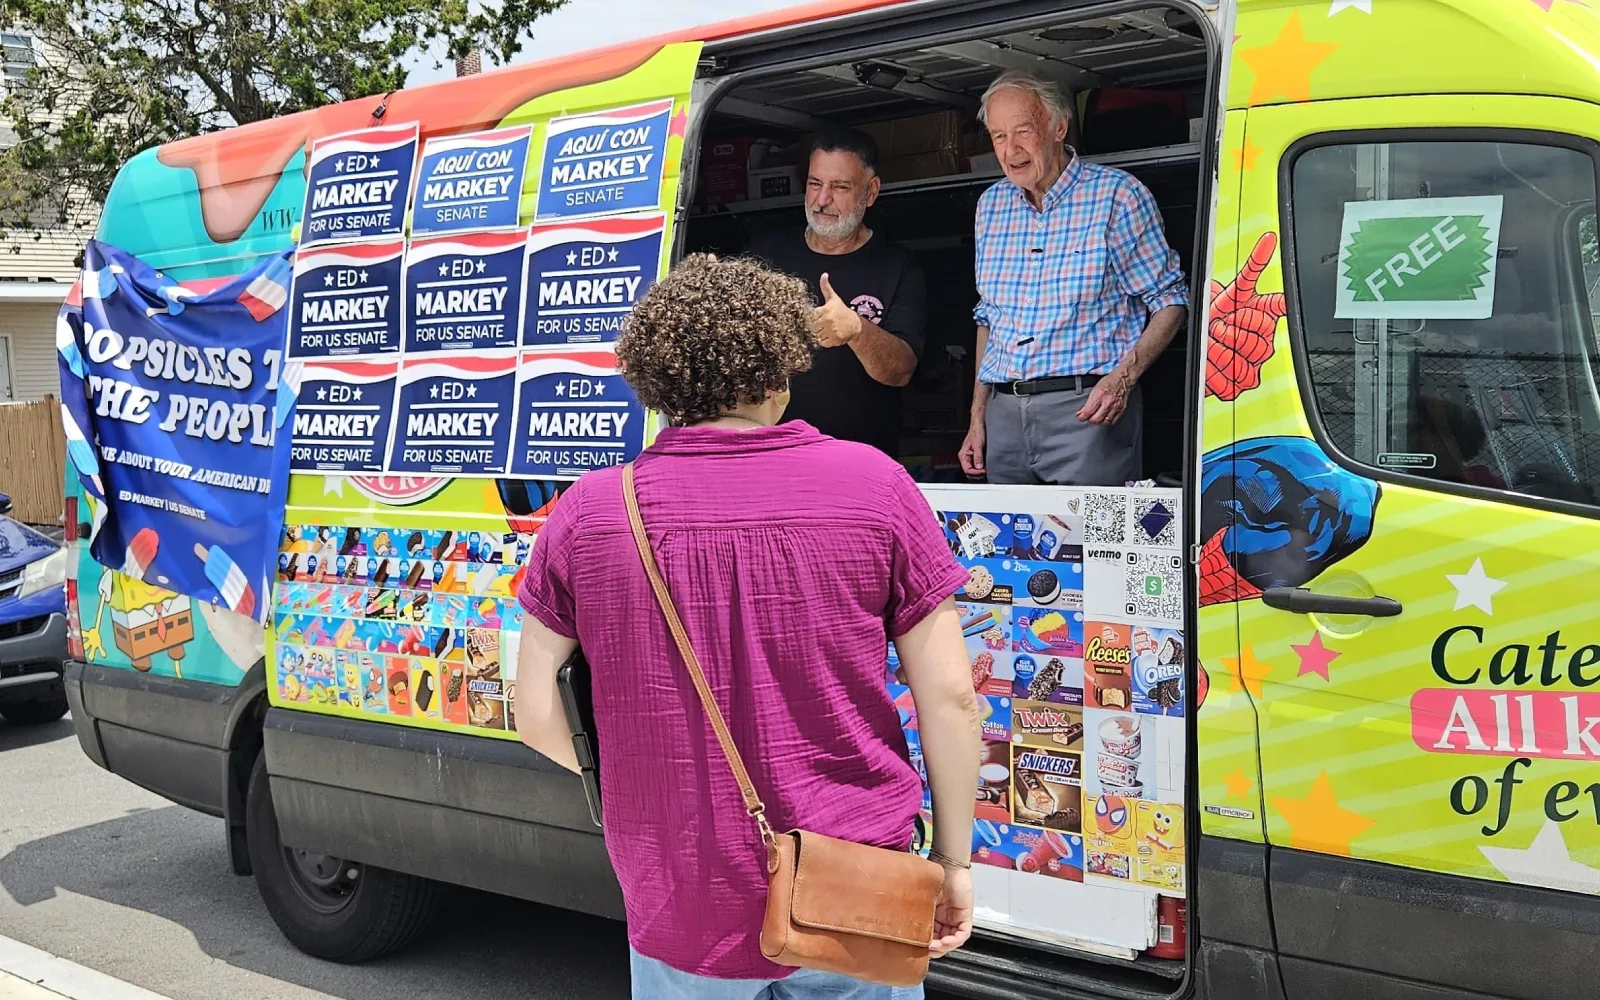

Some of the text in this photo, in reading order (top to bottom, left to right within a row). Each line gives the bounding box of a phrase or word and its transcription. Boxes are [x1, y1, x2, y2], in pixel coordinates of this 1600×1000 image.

[559, 126, 651, 156] AQUÍ CON
[346, 155, 367, 172] ED
[433, 149, 512, 175] AQUÍ CON
[551, 154, 653, 185] MARKEY
[312, 179, 398, 210] MARKEY
[424, 175, 514, 201] MARKEY
[565, 187, 624, 206] SENATE
[309, 213, 391, 233] FOR US SENATE
[436, 205, 488, 222] SENATE
[581, 247, 604, 266] ED
[1364, 216, 1466, 301] FREE
[452, 259, 474, 277] ED
[337, 270, 357, 287] ED
[416, 287, 508, 315] MARKEY
[539, 276, 642, 307] MARKEY
[302, 295, 389, 323] MARKEY
[416, 324, 504, 342] FOR US SENATE
[537, 320, 560, 334] FOR
[563, 318, 581, 332] US
[301, 331, 387, 347] FOR US SENATE
[329, 385, 351, 402] ED
[441, 382, 463, 400] ED
[569, 379, 591, 398] ED
[292, 414, 380, 436] MARKEY
[407, 413, 499, 436] MARKEY
[529, 412, 629, 437] MARKEY
[291, 447, 372, 462] FOR US SENATE
[403, 449, 493, 463] FOR US SENATE
[526, 450, 625, 466] FOR US SENATE
[117, 450, 153, 470] ABOUT
[154, 458, 192, 479] YOUR
[190, 468, 257, 491] AMERICAN
[119, 490, 131, 501] ED
[132, 493, 164, 508] MARKEY
[169, 500, 179, 512] US
[179, 504, 206, 520] SENATE
[1088, 549, 1121, 560] venmo
[1431, 625, 1600, 687] Cate
[1145, 665, 1182, 684] OREO
[470, 681, 498, 692] SNICKERS
[981, 721, 1004, 729] Cotton
[984, 728, 1006, 737] Candy
[1433, 693, 1541, 753] All
[1020, 753, 1073, 774] SNICKERS
[1450, 758, 1532, 836] of
